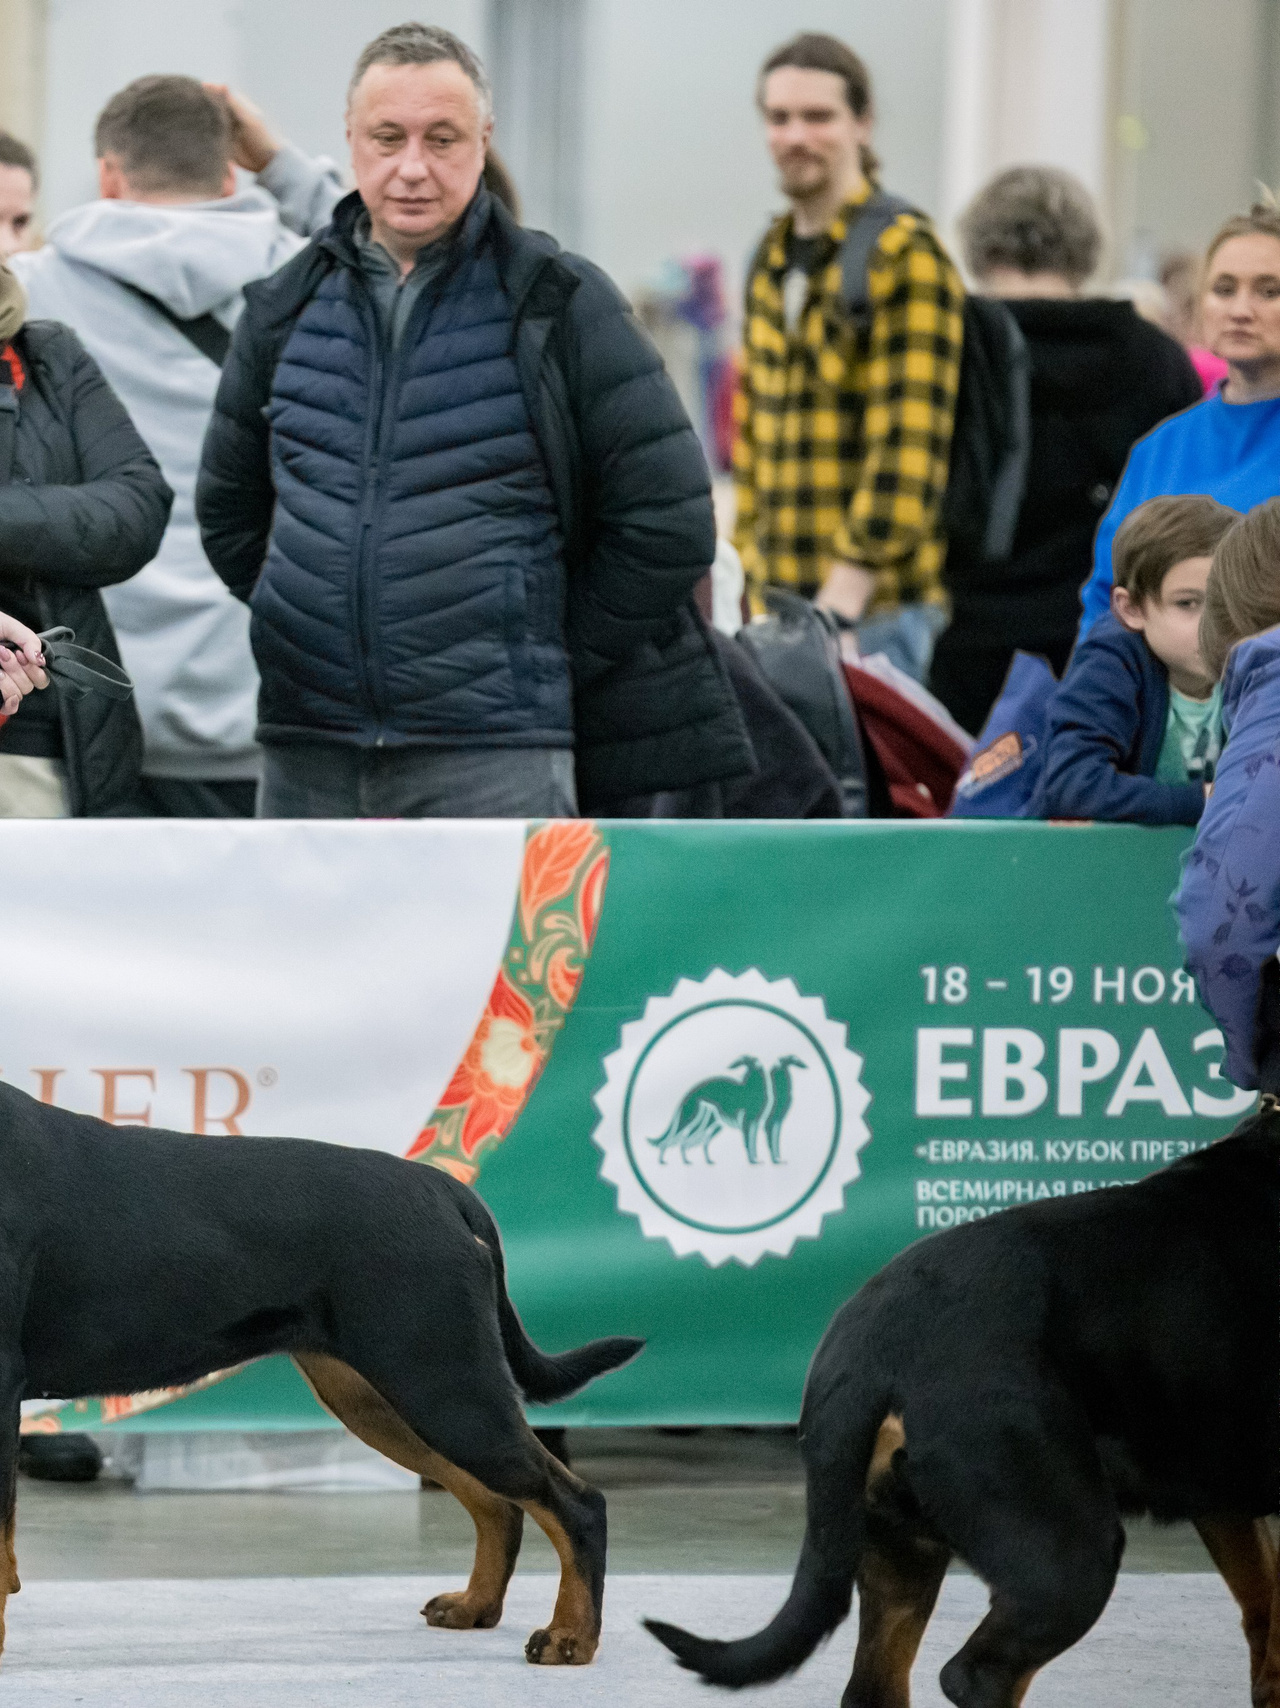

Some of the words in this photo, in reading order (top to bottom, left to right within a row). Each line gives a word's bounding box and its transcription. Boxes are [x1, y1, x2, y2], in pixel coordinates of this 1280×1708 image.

[921, 966, 968, 1003] 18
[1026, 966, 1073, 1003] 19
[1094, 966, 1195, 1004] НОЯ
[1045, 1138, 1126, 1163] КУБОК
[916, 1179, 1067, 1201] ВСЕМИРНАЯ
